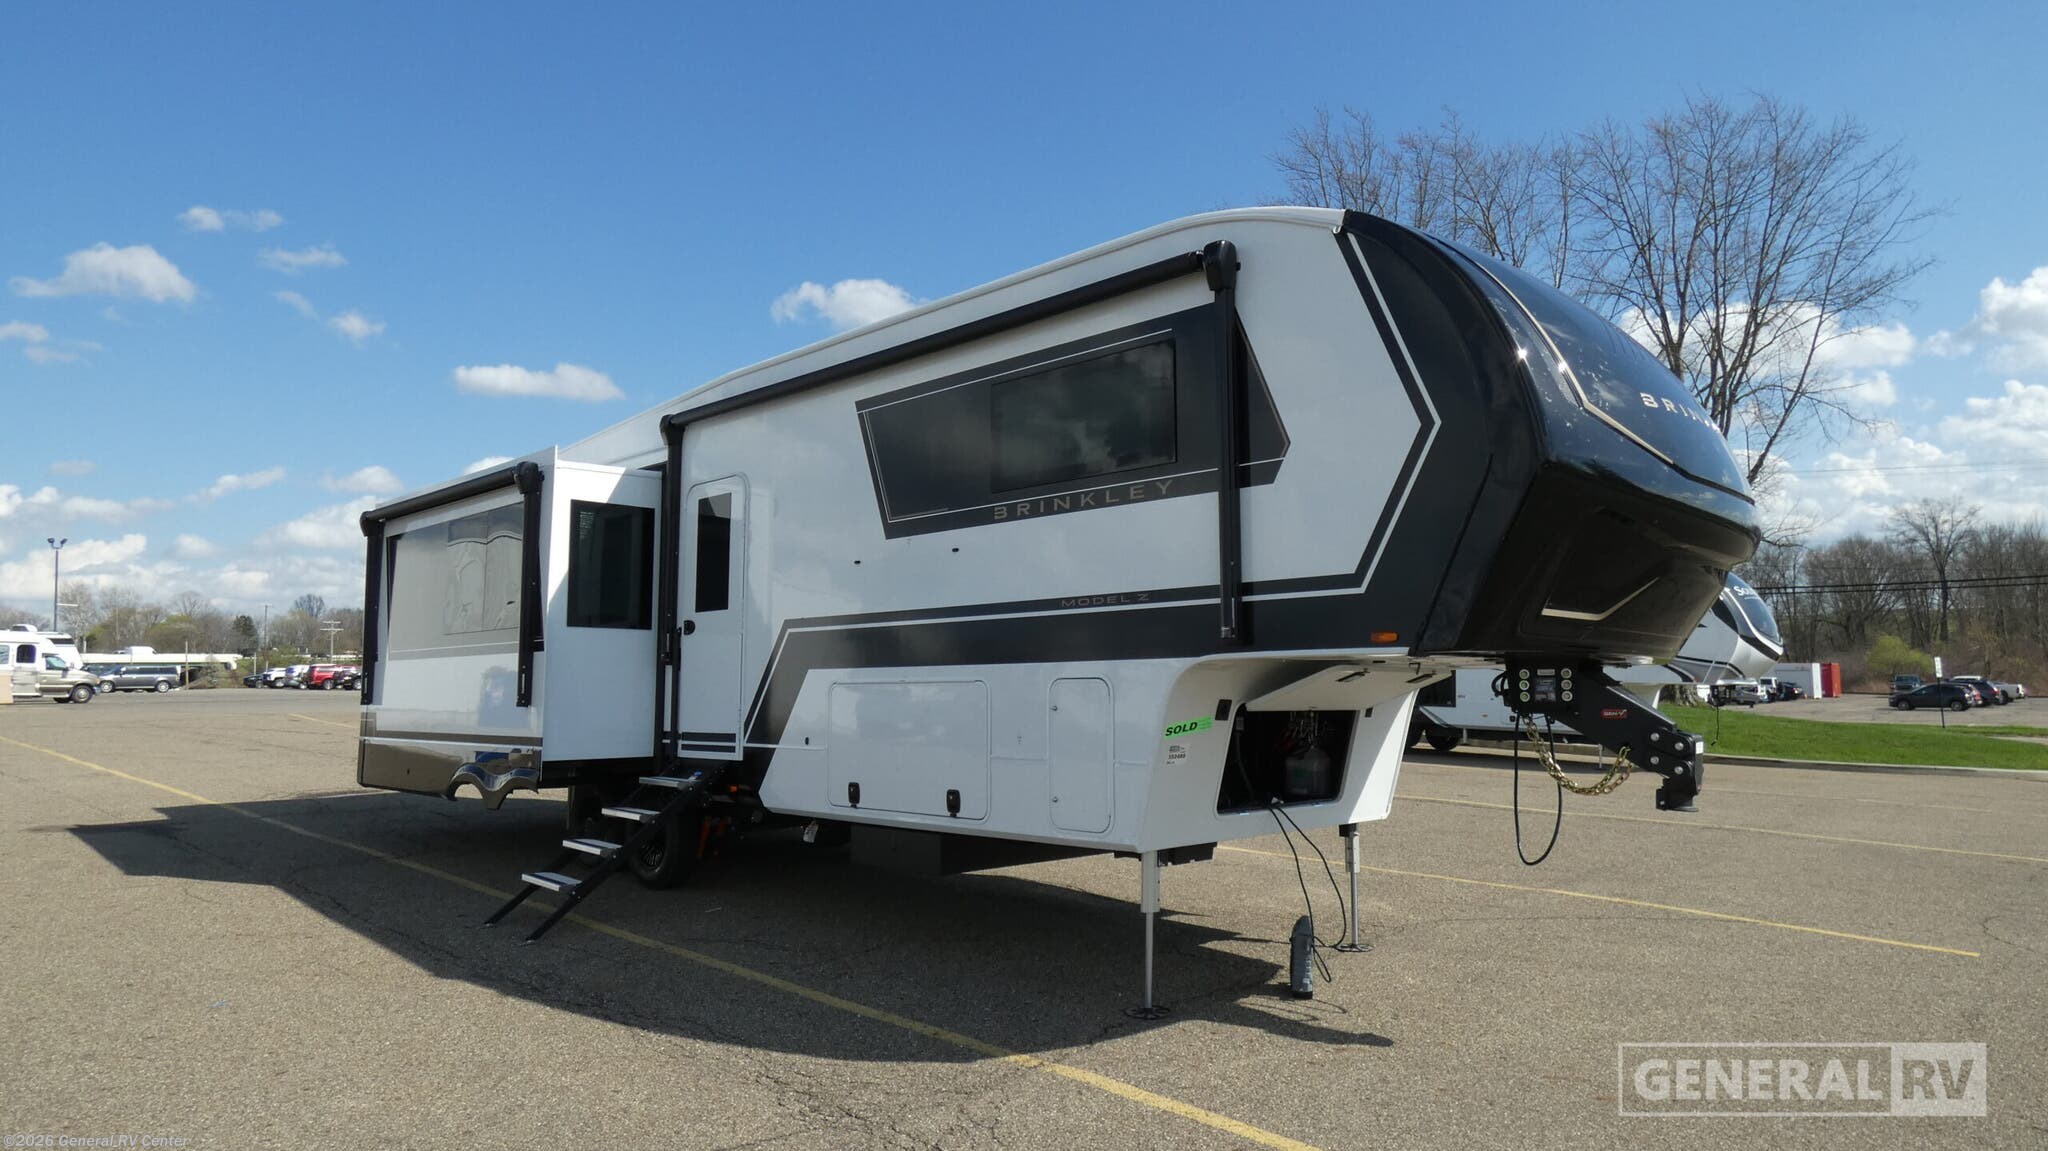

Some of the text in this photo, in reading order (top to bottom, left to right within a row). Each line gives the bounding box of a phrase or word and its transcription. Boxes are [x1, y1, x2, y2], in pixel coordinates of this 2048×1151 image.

[1640, 392, 1720, 432] BRIN
[994, 479, 1173, 520] BRINKLEY
[1061, 593, 1150, 608] MODEL Z
[1165, 721, 1198, 737] SOLD
